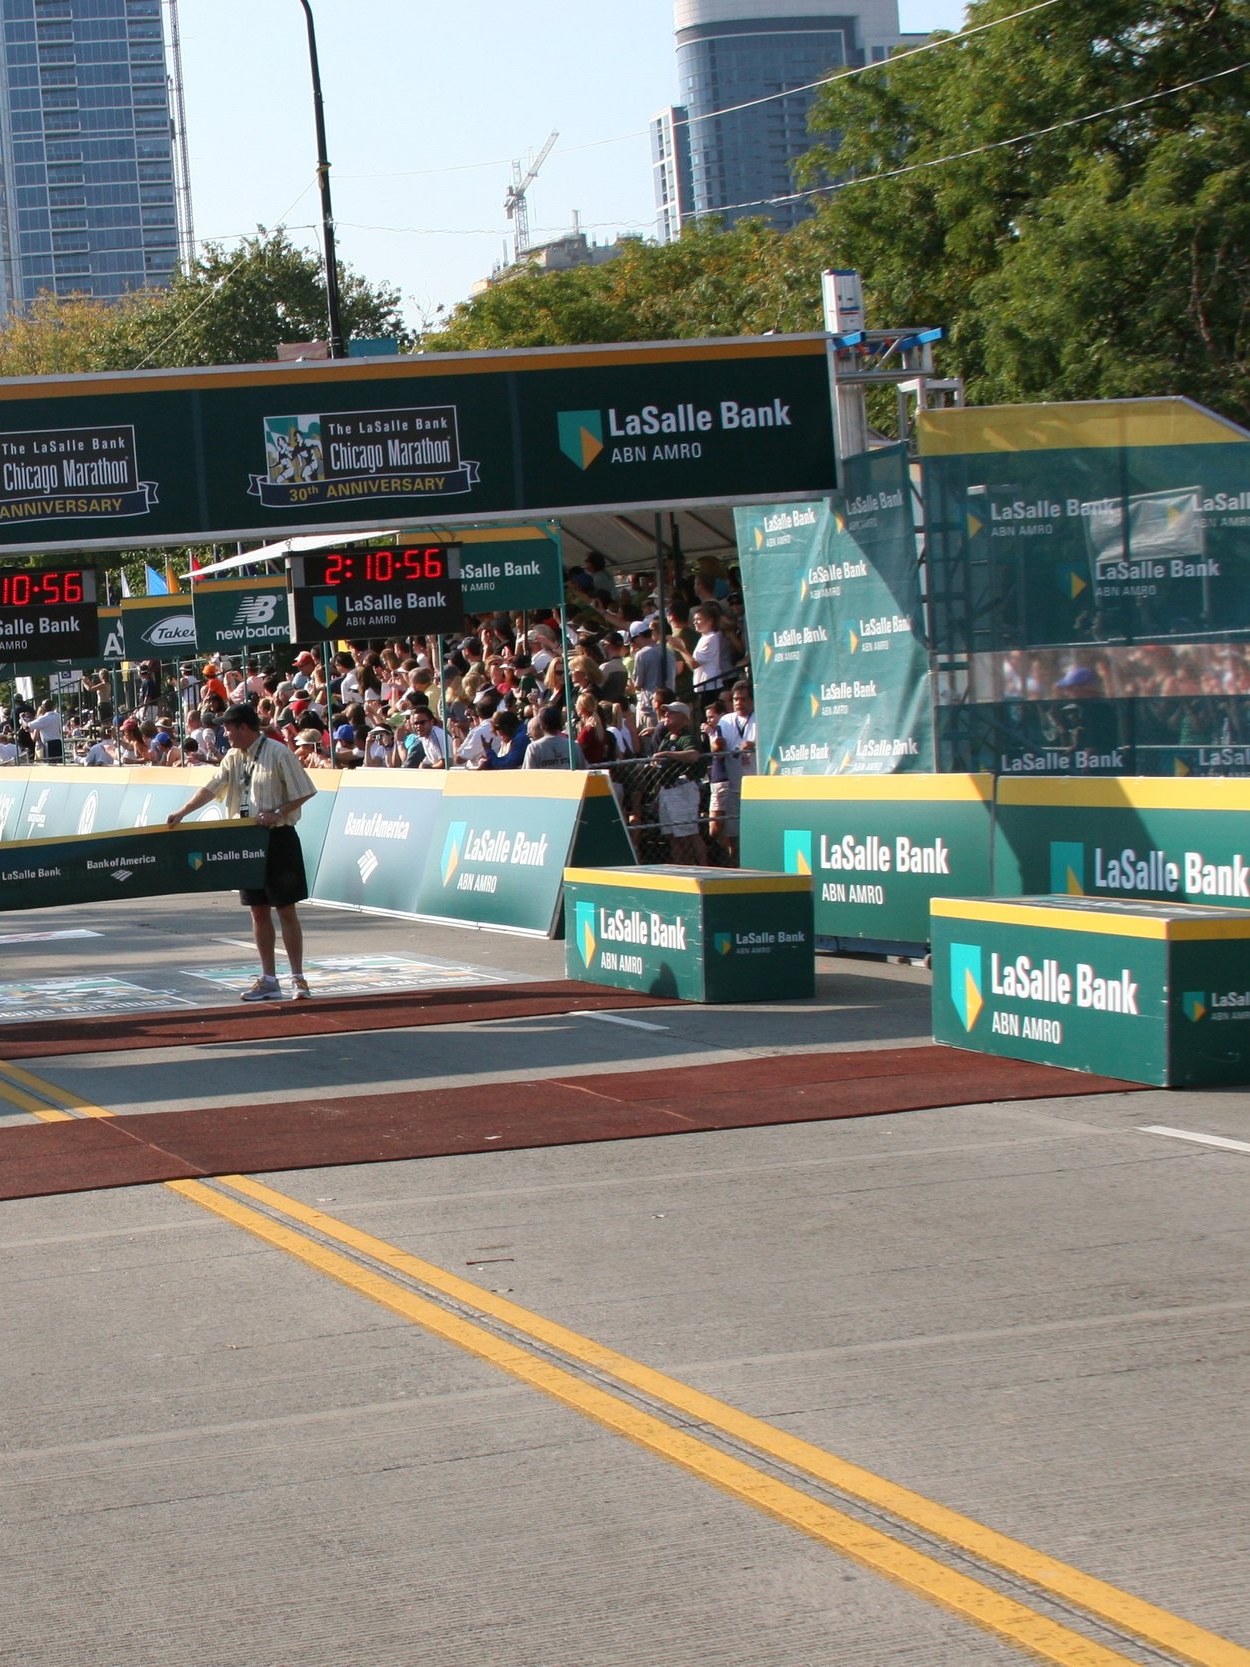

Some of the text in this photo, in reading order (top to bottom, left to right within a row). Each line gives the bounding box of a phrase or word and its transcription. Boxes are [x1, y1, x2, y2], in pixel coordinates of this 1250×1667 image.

[328, 416, 447, 435] The LaSalle Bank
[608, 398, 791, 437] LaSalle Bank
[1, 436, 125, 455] The LaSalle Bank
[330, 436, 451, 473] Chicago Marathon
[611, 442, 702, 463] ABN AMRO
[3, 457, 128, 494] Chicago Marathon
[289, 476, 446, 502] 30th ANNIVERSARY
[0, 498, 122, 519] ANNIVERSARY
[846, 489, 903, 515] LaSalle Bank
[990, 498, 1116, 521] LaSalle Bank
[1193, 491, 1250, 511] LaSall
[764, 507, 816, 533] LaSalle Bank
[991, 523, 1053, 537] ABN AMRO
[459, 560, 540, 579] aSalle Bank
[808, 560, 867, 585] LaSalle Bank
[1096, 558, 1220, 581] LaSalle Bank
[470, 581, 495, 592] AMRO
[1096, 586, 1119, 598] ABN
[345, 591, 446, 612] LaSalle Bank
[39, 616, 80, 634] Bank
[346, 614, 397, 627] ABN AMRO
[860, 614, 911, 636] LaSalle Bank
[158, 627, 195, 640] Take
[216, 625, 290, 641] new balanc
[773, 625, 827, 648] LaSalle Bank
[0, 640, 28, 651] AMRO
[821, 679, 877, 701] LaSalle Bank
[779, 742, 830, 762] LaSalle Bank
[855, 737, 918, 757] LaSalle Bank
[1200, 748, 1250, 766] LaSal
[1000, 750, 1124, 773] LaSalle Bank
[206, 849, 266, 862] LaSalle Bank
[464, 829, 549, 866] LaSalle Bank
[820, 835, 949, 874] LaSalle Bank
[1, 867, 61, 882] LaSalle Bank
[457, 872, 498, 894] ABN AMRO
[1095, 848, 1250, 897] LaSalle Bank
[822, 883, 884, 905] ABN AMRO
[600, 907, 687, 951] LaSalle Bank
[736, 930, 805, 945] LaSalle Bank
[600, 951, 643, 975] ABN AMRO
[991, 952, 1138, 1015] LaSalle Bank
[1211, 991, 1250, 1007] LaSal
[991, 1011, 1061, 1045] ABN AMRO
